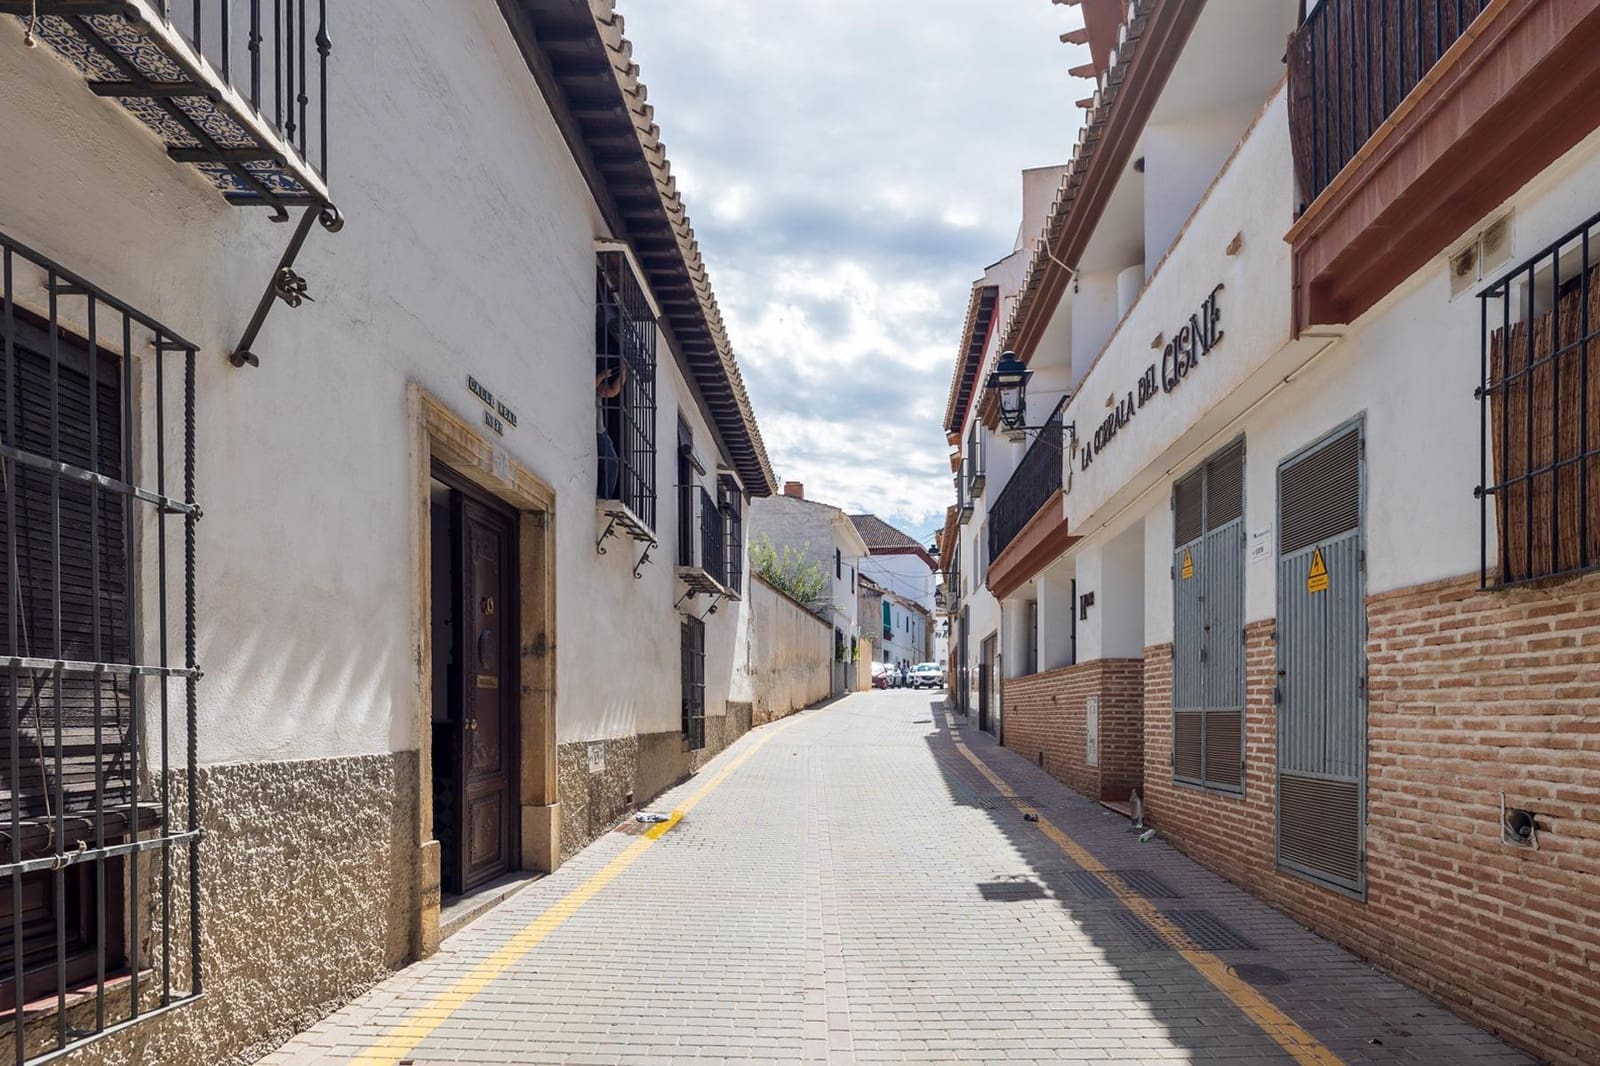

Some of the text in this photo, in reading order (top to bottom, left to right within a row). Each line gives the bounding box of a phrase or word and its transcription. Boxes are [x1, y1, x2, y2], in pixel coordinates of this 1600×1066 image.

[467, 374, 495, 410] CALLE
[1081, 283, 1225, 471] LA CORRALA DEL CISNE
